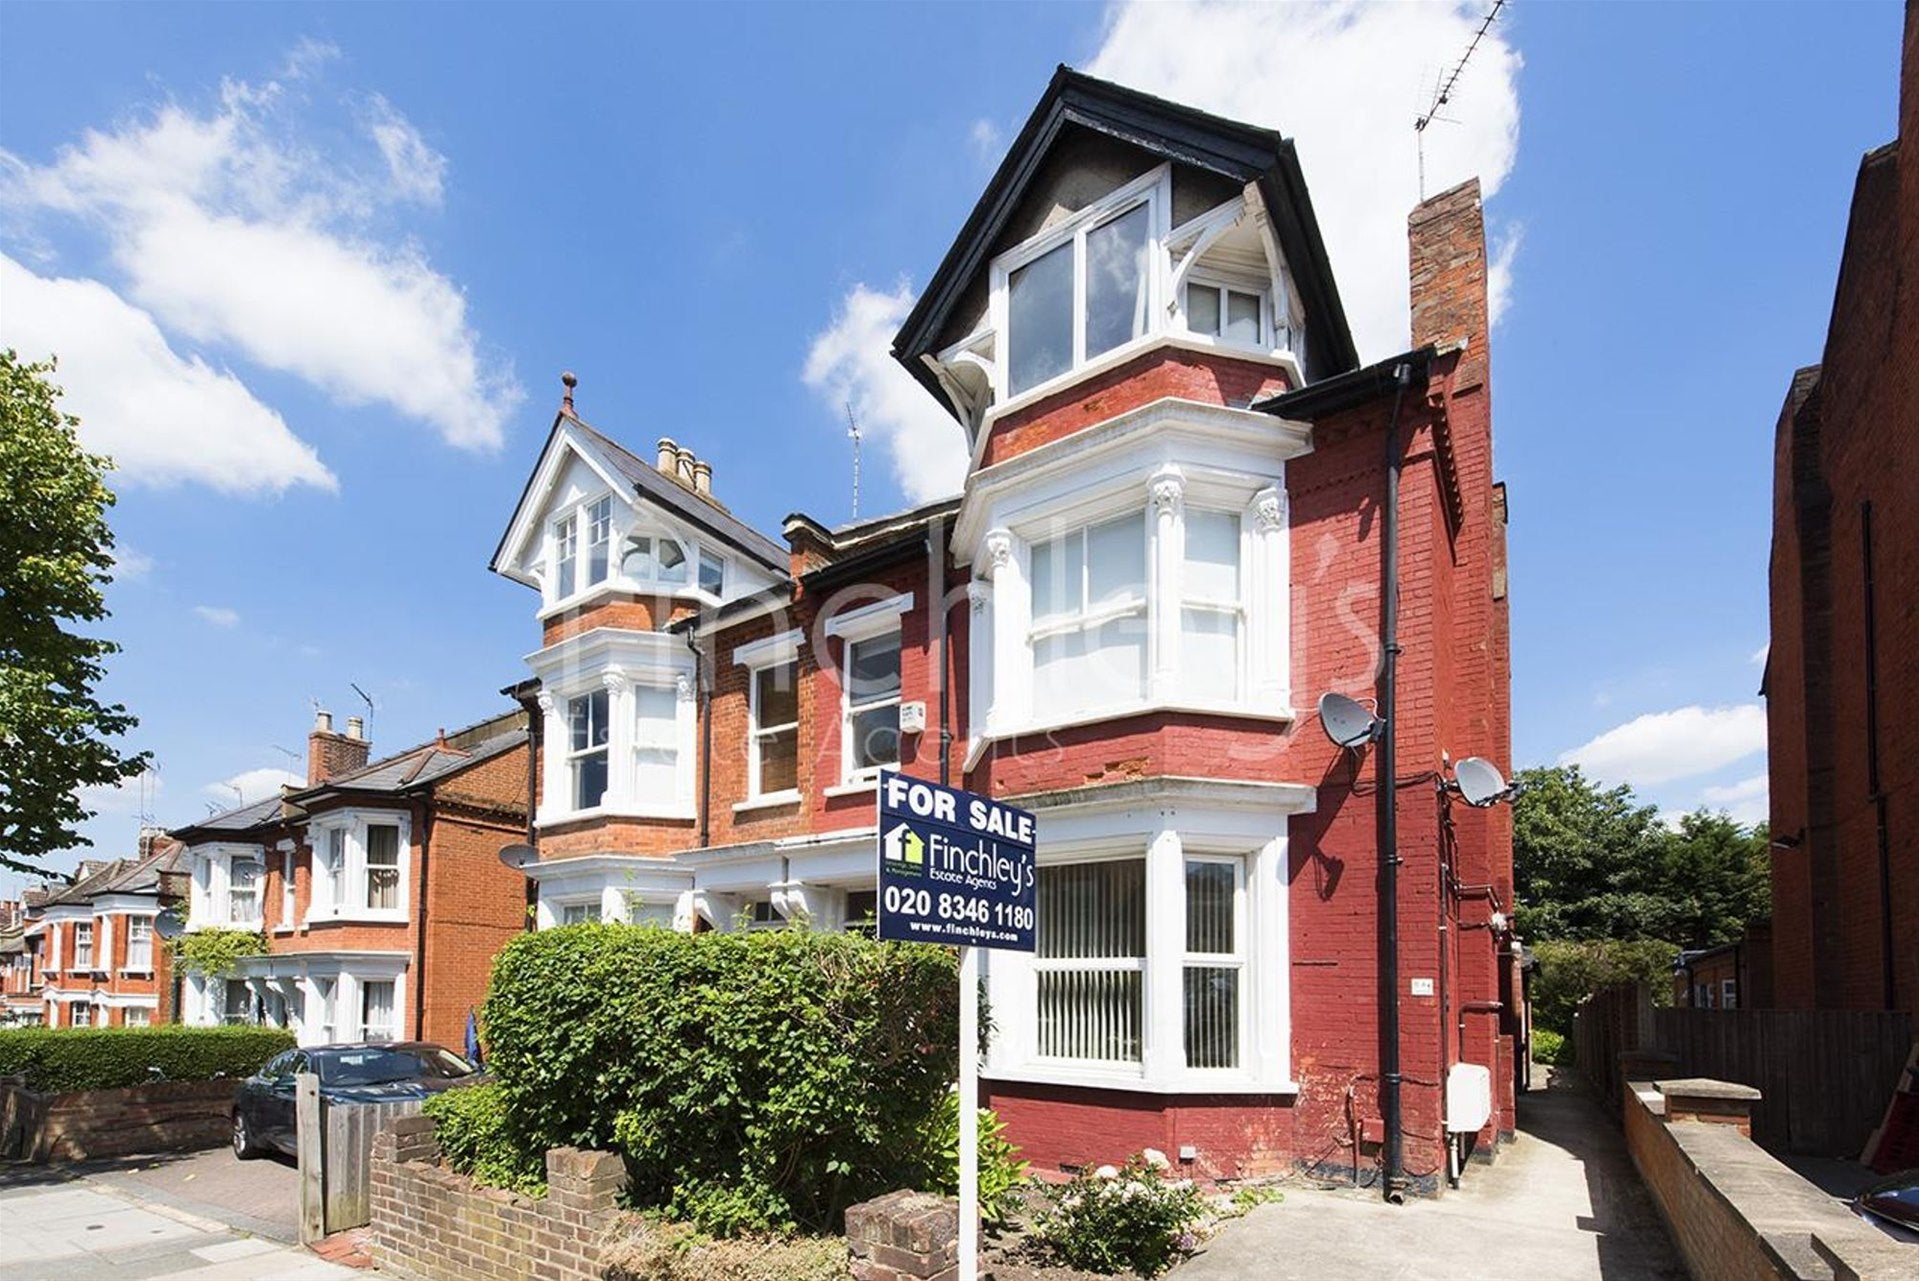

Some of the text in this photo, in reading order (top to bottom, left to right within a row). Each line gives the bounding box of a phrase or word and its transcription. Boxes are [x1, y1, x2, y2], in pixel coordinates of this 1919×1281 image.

[888, 778, 1032, 844] FOR SALE
[930, 833, 1034, 896] Finchley's
[930, 867, 997, 890] Estate Agents
[885, 886, 1033, 930] 020 8346 1180
[910, 922, 1018, 941] www.finchleys.com
